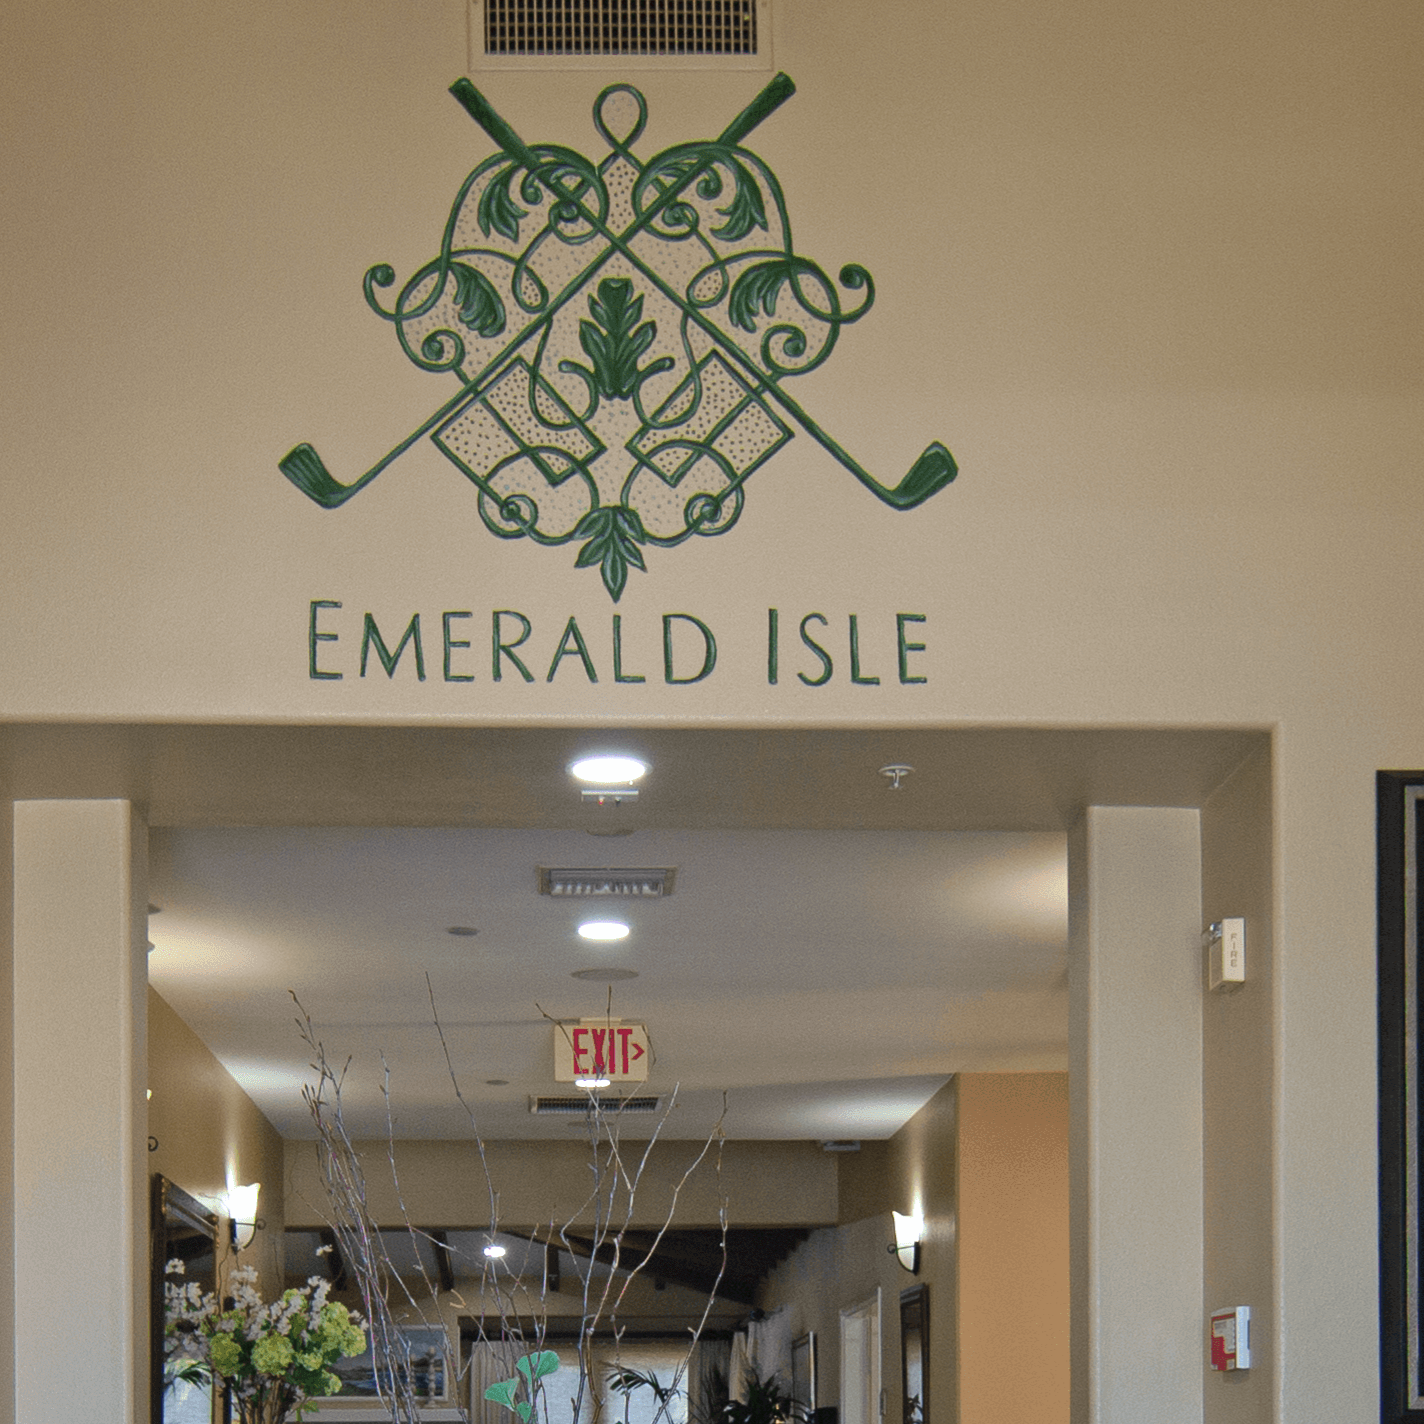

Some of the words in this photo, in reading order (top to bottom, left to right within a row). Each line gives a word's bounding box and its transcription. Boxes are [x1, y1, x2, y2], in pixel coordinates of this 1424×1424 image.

[308, 599, 718, 685] EMERALD
[767, 607, 928, 687] ISLE
[1230, 932, 1238, 968] FIRE
[573, 1028, 633, 1075] EXIT
